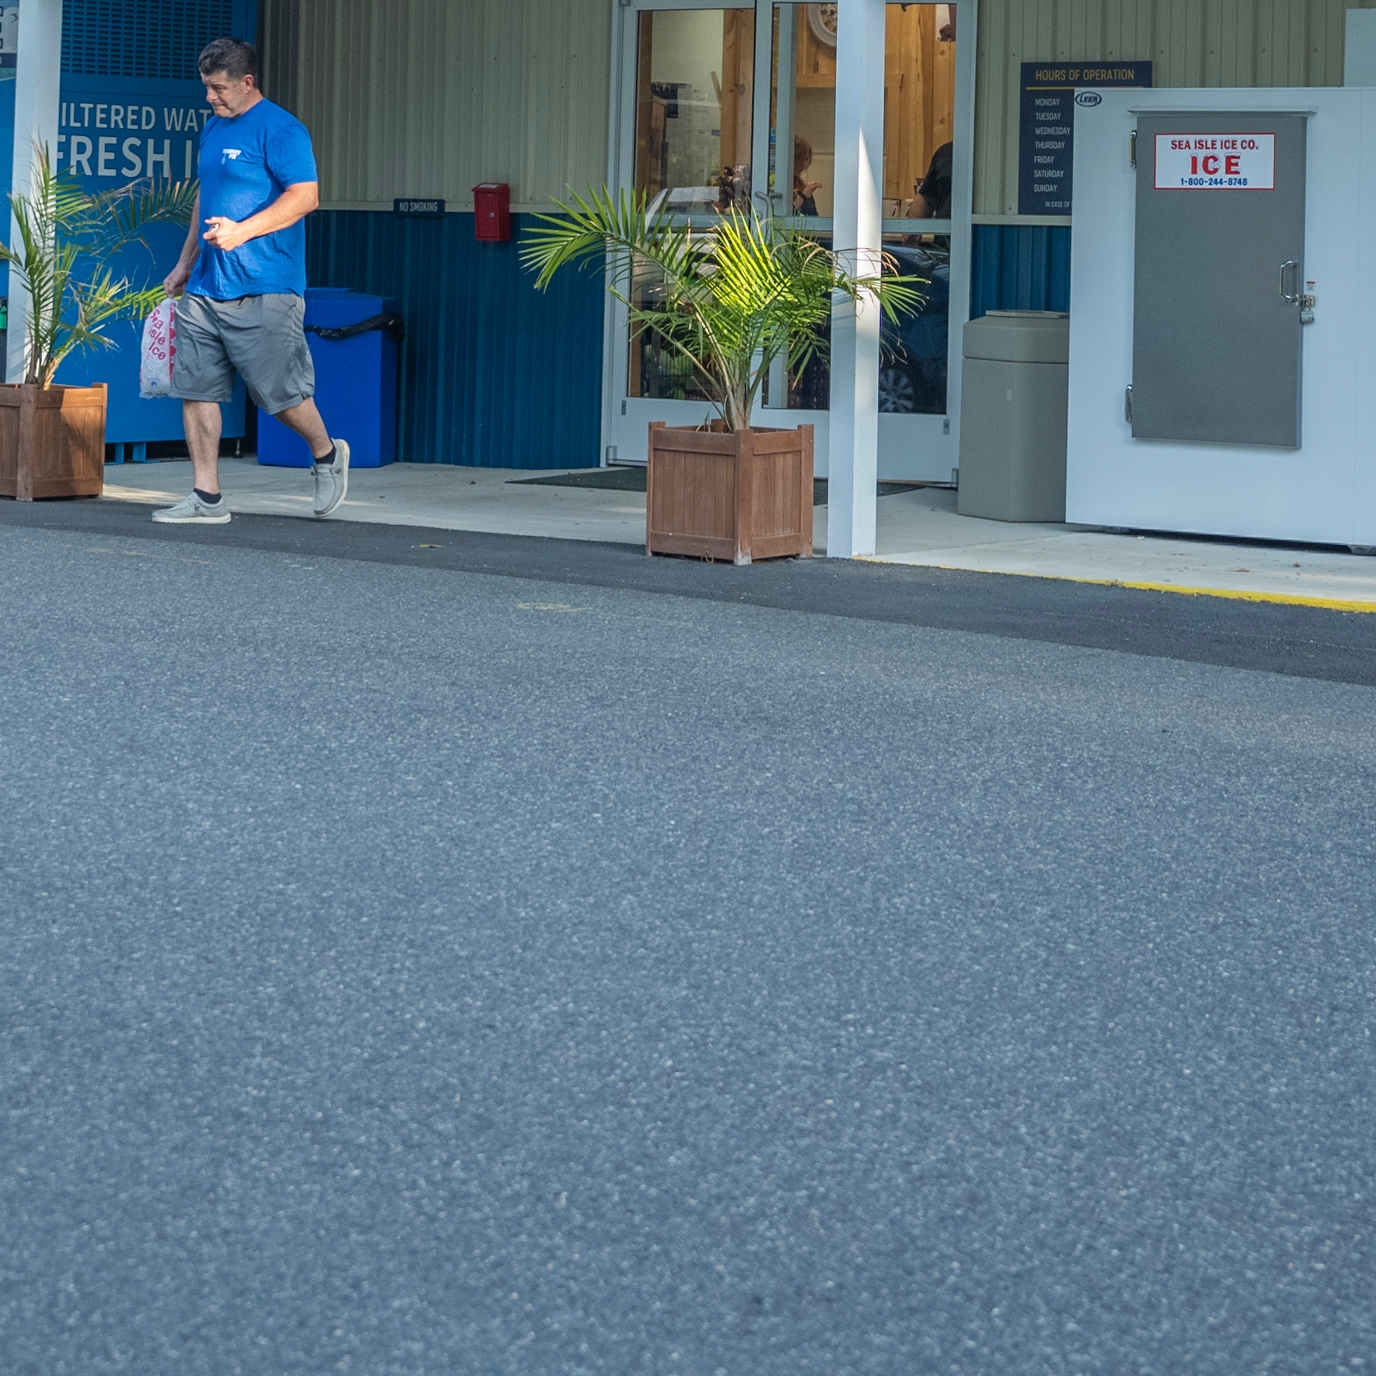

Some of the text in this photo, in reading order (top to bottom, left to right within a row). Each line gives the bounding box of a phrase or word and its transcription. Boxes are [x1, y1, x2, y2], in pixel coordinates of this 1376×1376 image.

[1035, 69, 1135, 81] HOURS OF OPERATION
[1035, 98, 1060, 106] MONDAY
[1078, 93, 1099, 105] LEER
[61, 102, 212, 132] ILTERED WAT
[1034, 127, 1071, 135] WEDNESDAY
[1034, 141, 1065, 149] THURSDAY
[1171, 140, 1259, 150] SEA ISLE ICE CO.
[1034, 155, 1055, 164] FRIDAY
[1190, 153, 1241, 175] ICE
[1034, 169, 1064, 178] SATURDAY
[1033, 184, 1058, 192] SUNDAY
[399, 202, 438, 212] NO SMOKING
[148, 341, 166, 360] Ice
